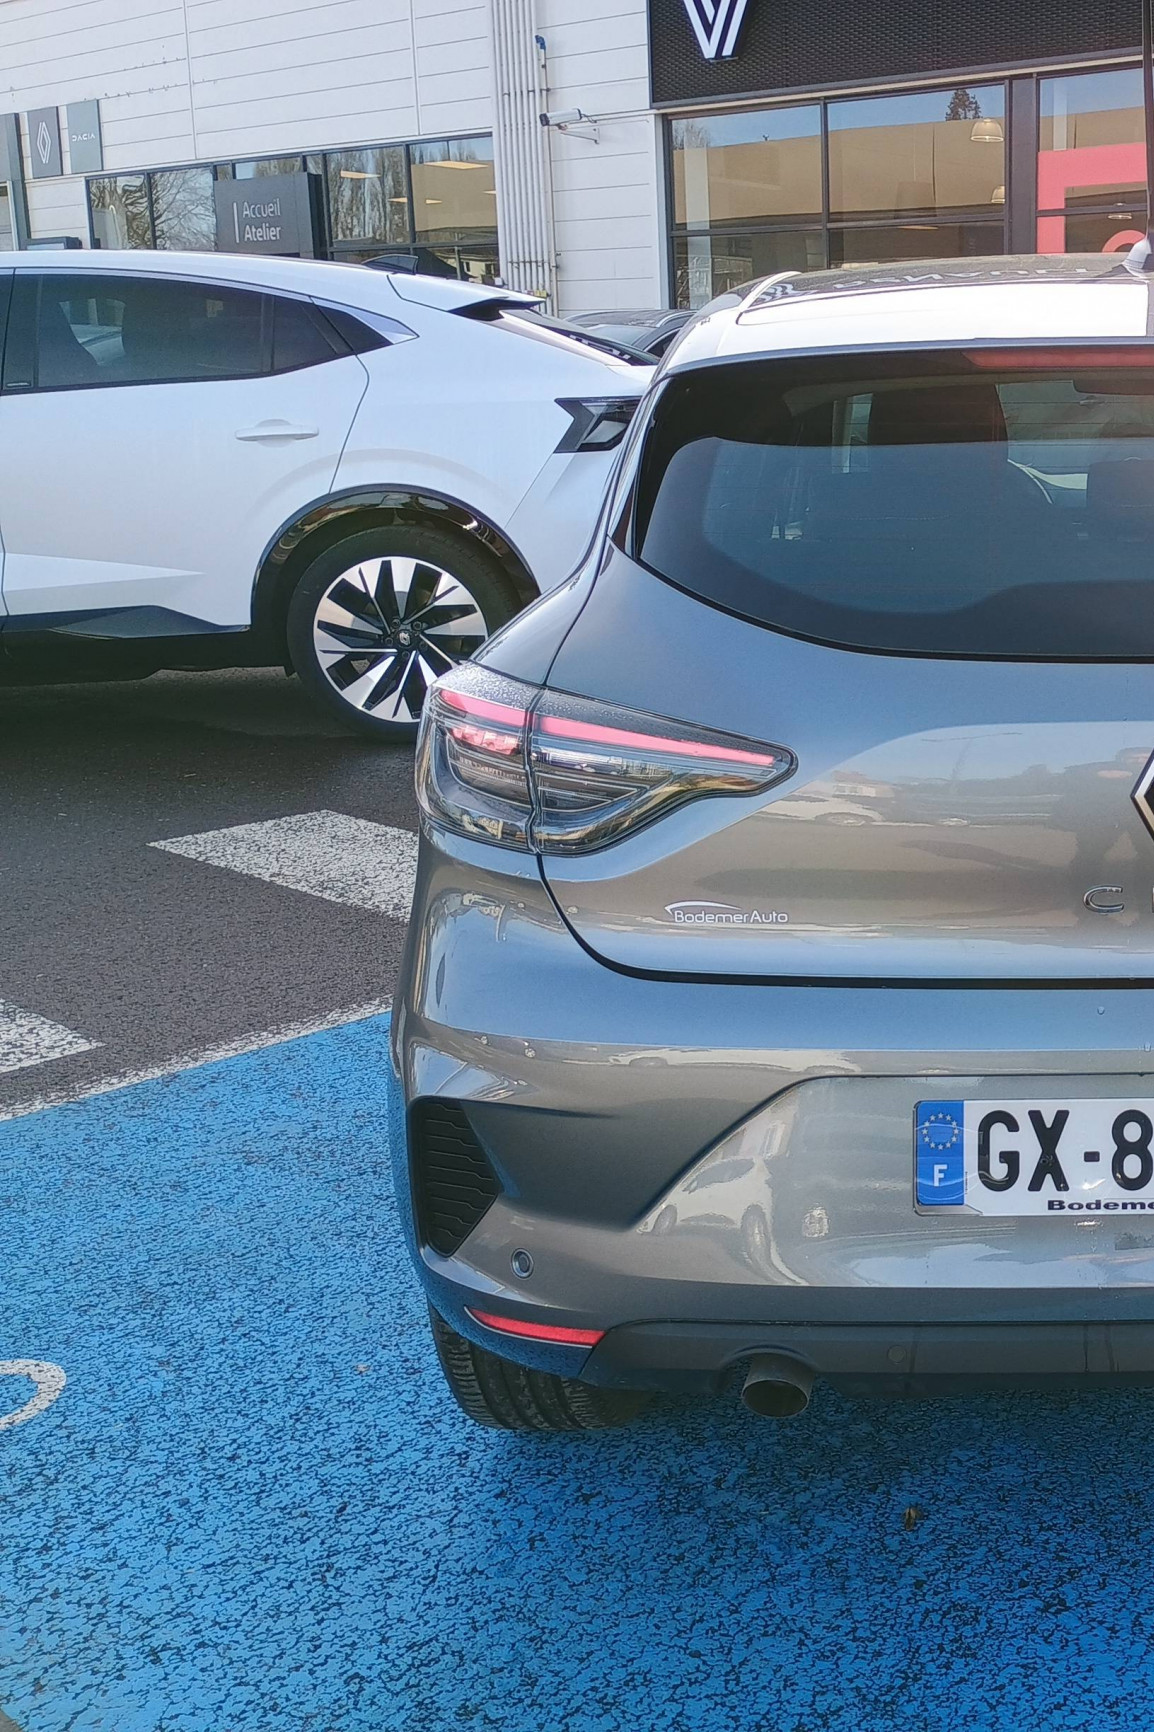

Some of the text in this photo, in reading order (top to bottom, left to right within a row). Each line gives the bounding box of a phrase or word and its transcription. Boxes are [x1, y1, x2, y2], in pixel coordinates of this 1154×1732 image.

[72, 133, 96, 142] DACIA
[243, 198, 281, 218] Accueil
[244, 222, 282, 242] Atelier
[674, 910, 788, 923] BodemerAuto
[933, 1164, 947, 1187] F
